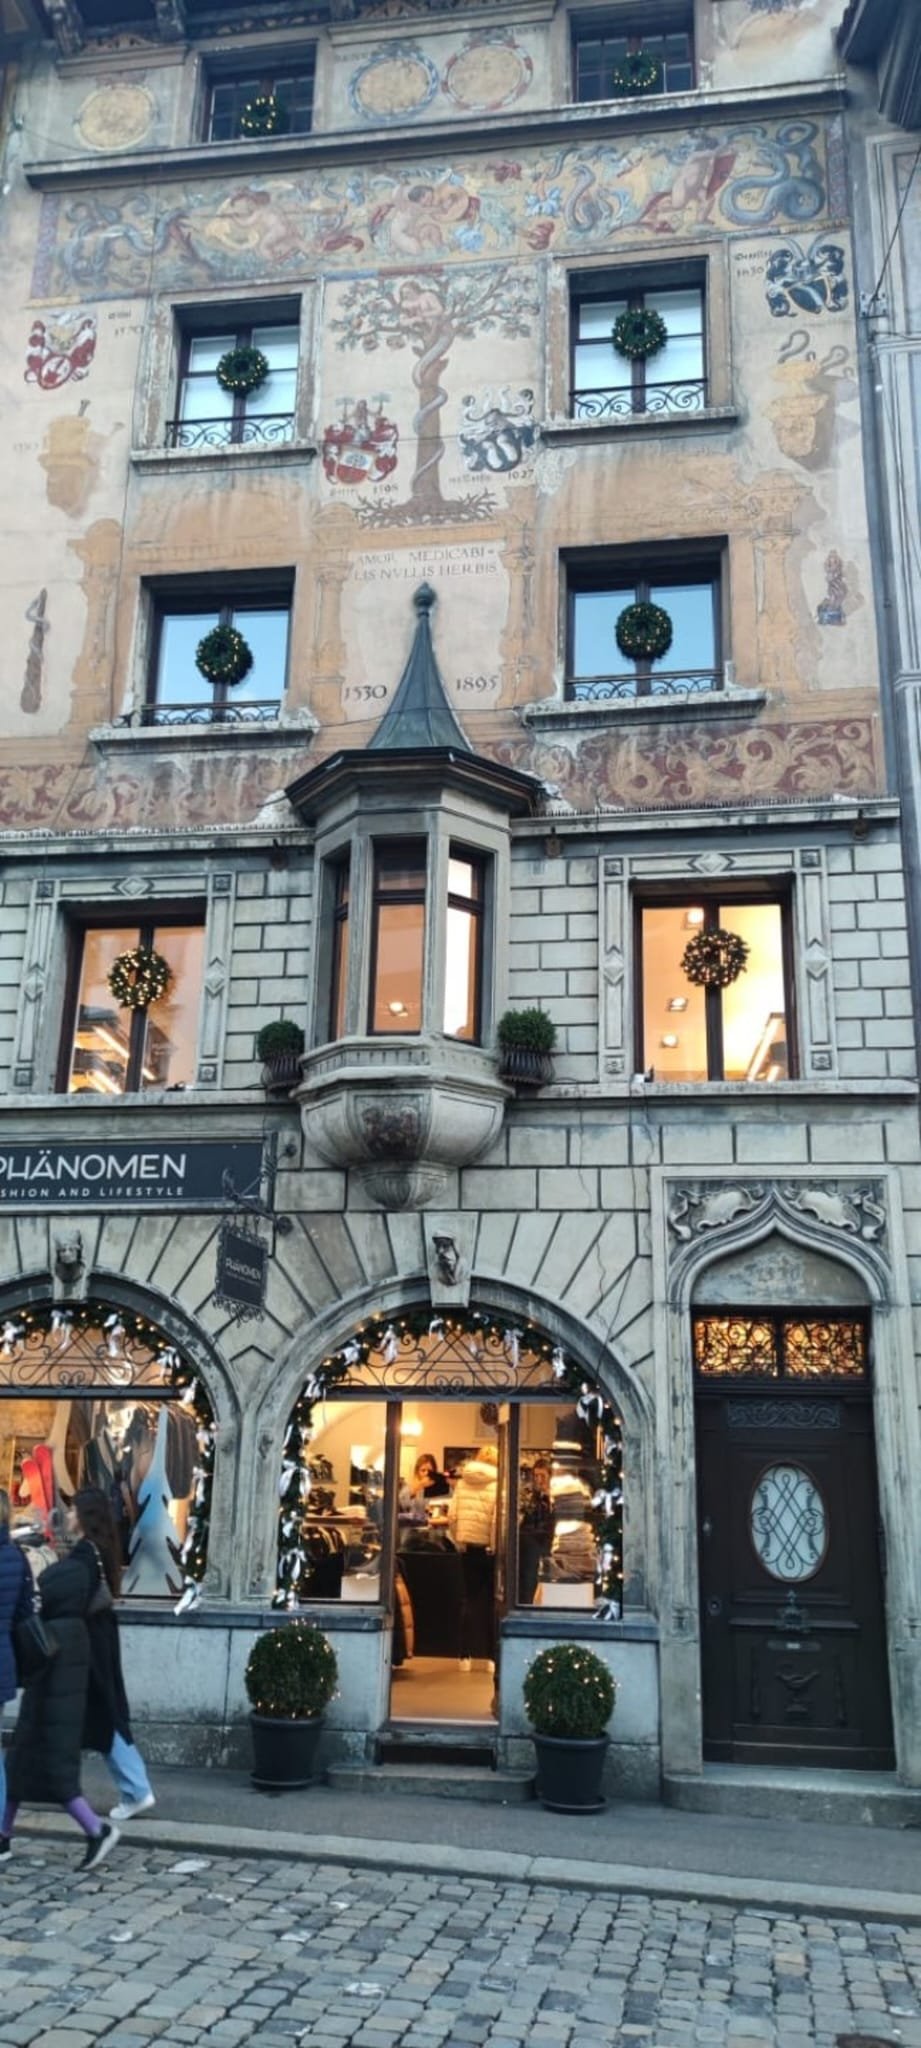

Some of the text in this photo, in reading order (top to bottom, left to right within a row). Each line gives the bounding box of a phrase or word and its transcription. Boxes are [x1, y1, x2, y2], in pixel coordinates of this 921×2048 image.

[439, 562, 498, 578] HERBIS
[456, 675, 498, 692] 1895
[345, 684, 388, 700] 1530
[58, 1188, 90, 1197] AND
[100, 1186, 184, 1197] LIFESTYLE
